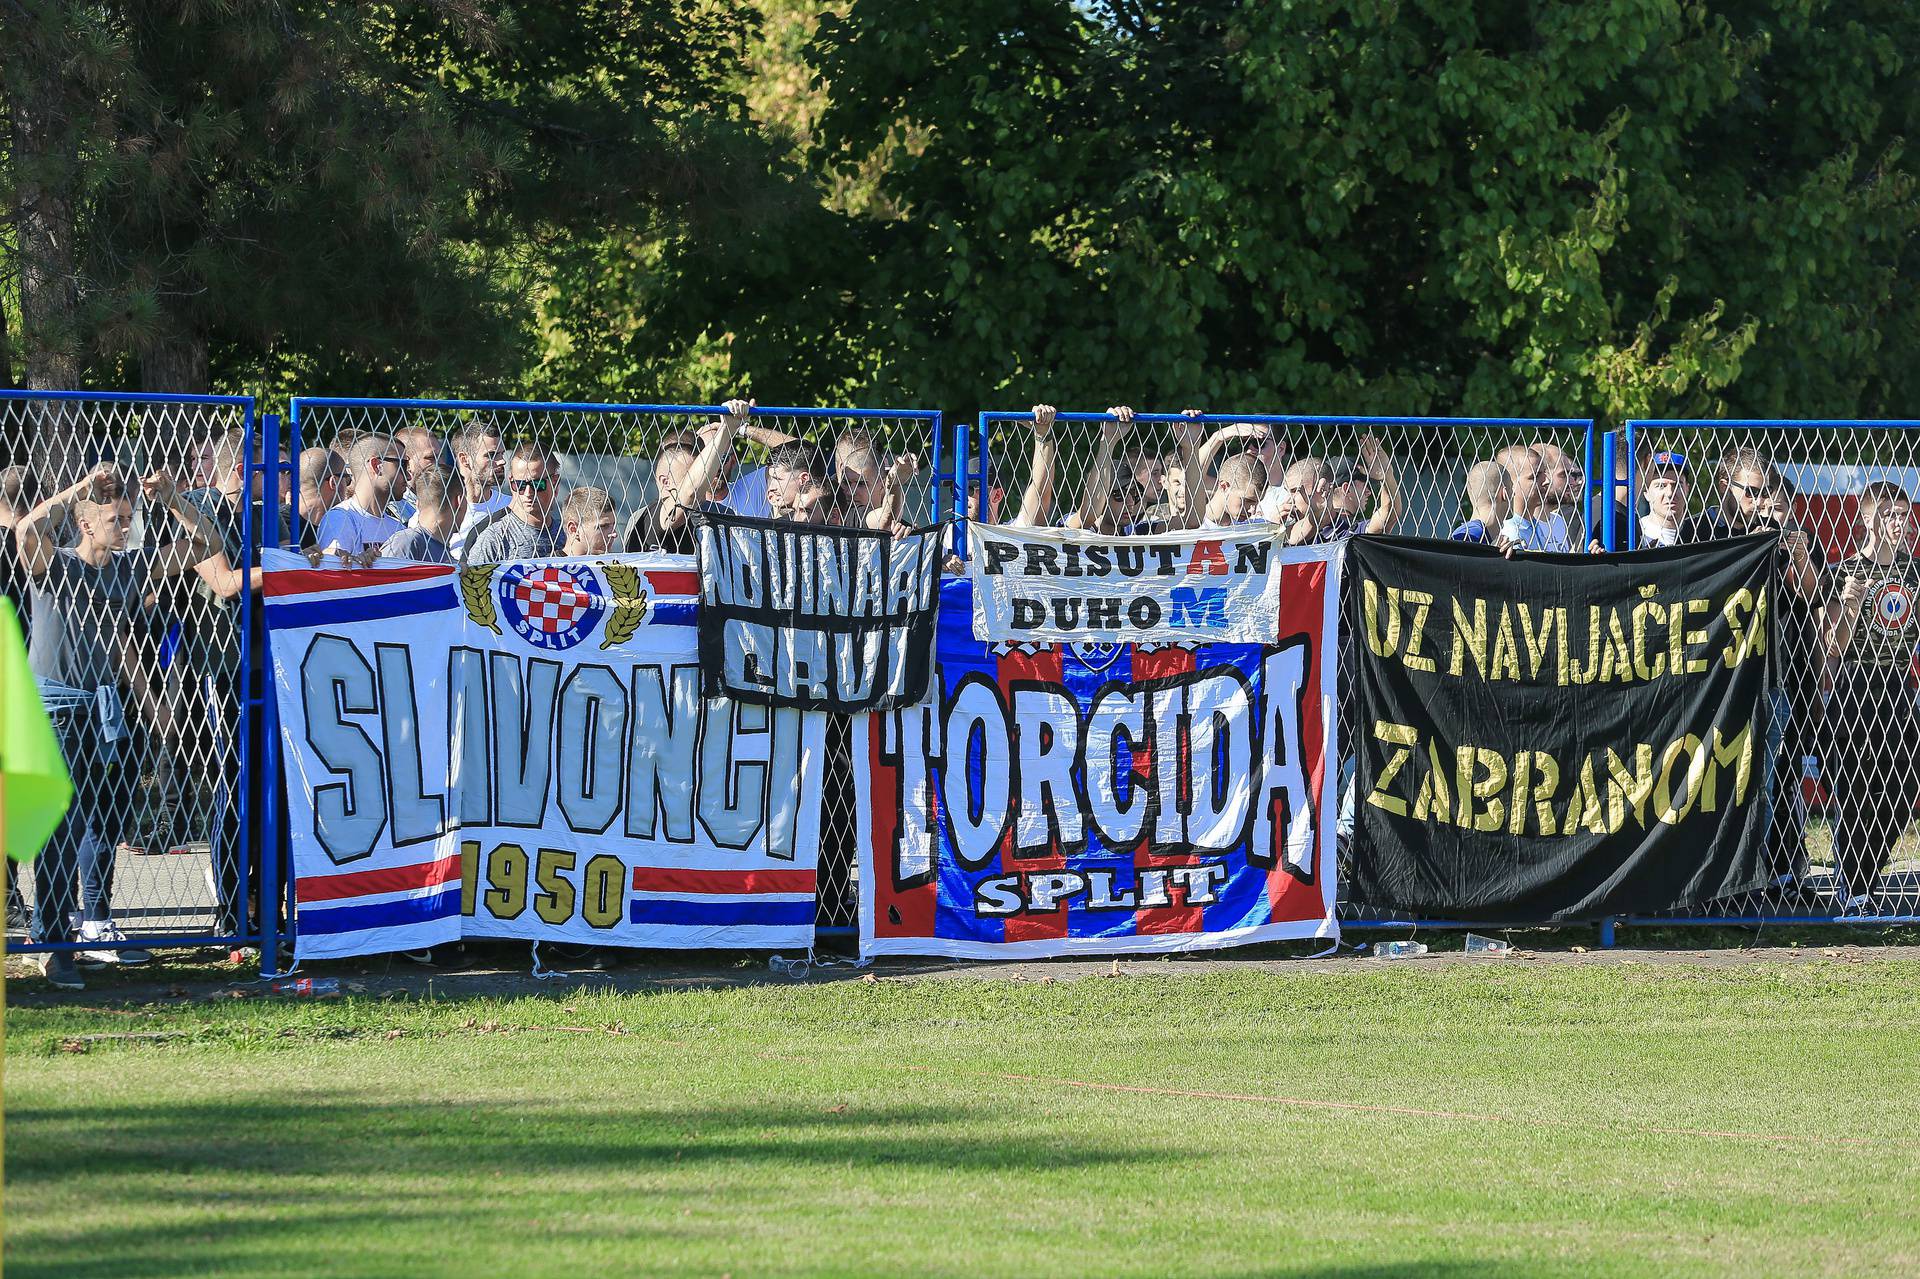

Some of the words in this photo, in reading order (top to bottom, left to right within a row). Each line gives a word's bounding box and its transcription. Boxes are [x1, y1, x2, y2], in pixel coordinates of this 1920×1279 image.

[984, 539, 1271, 577] PRISUTAN
[515, 619, 581, 649] SPLIT
[1010, 587, 1229, 630] DUHOM
[1363, 578, 1436, 673] UZ
[723, 618, 910, 702] CRVI
[300, 632, 803, 865] SLAVONCI
[879, 634, 1315, 890] TORCIDA
[1366, 719, 1752, 836] ZABRANOM
[461, 840, 627, 929] 1950
[973, 859, 1230, 918] SPLIT
